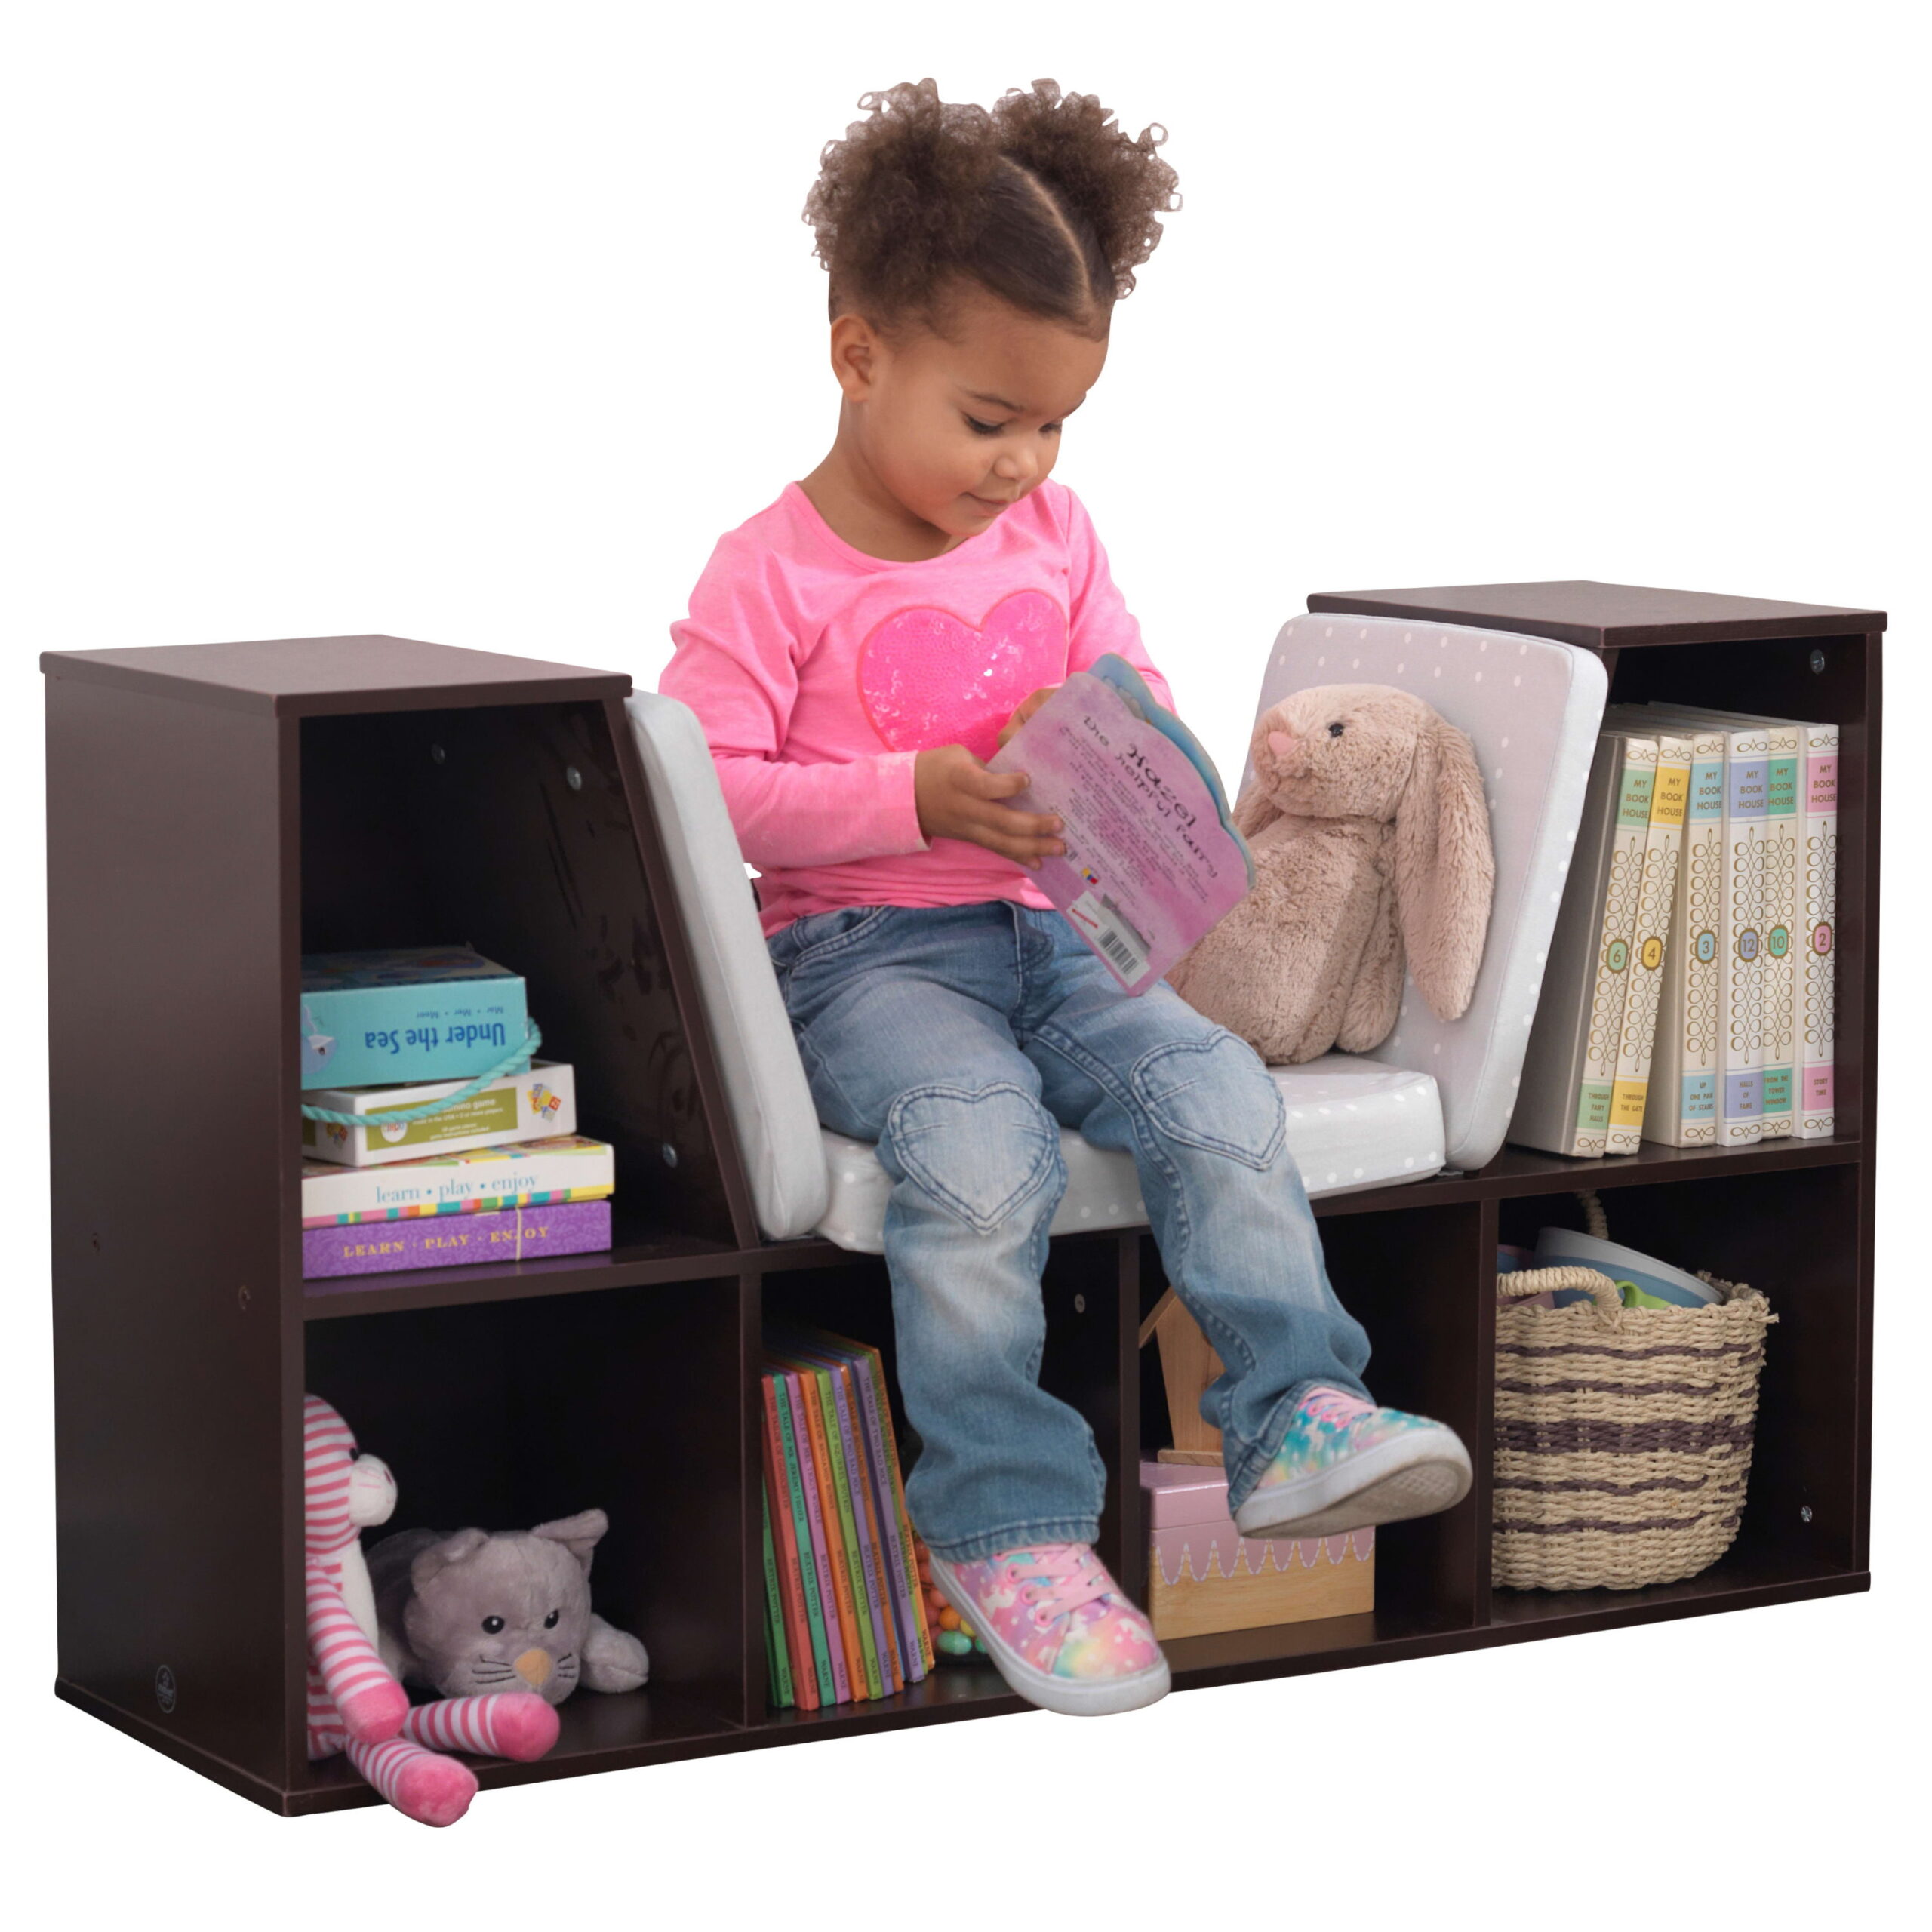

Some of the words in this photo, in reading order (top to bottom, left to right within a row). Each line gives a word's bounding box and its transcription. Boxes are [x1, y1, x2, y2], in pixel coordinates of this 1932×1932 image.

[1706, 771, 1718, 780] MY
[1746, 771, 1759, 779] MY
[1777, 768, 1789, 777] MY
[1820, 764, 1832, 774] MY
[1127, 743, 1197, 827] Hazel
[1634, 780, 1647, 788] MY
[1668, 778, 1681, 786] MY
[1770, 782, 1793, 791] BOOK
[1814, 779, 1835, 789] BOOK
[1700, 786, 1721, 795] BOOK
[1740, 785, 1763, 794] BOOK
[1084, 716, 1109, 746] the
[1115, 752, 1171, 817] helpful
[1176, 824, 1217, 878] fairy
[1626, 793, 1649, 804] BOOK
[1660, 792, 1683, 802] BOOK
[1738, 799, 1764, 809] HOUSE
[1768, 796, 1794, 806] HOUSE
[1811, 793, 1836, 803] HOUSE
[1657, 807, 1683, 817] HOUSE
[1697, 801, 1721, 811] HOUSE
[1623, 809, 1648, 819] HOUSE
[1743, 939, 1755, 952] 12
[1772, 935, 1784, 949] 10
[1819, 933, 1826, 946] 2
[1647, 947, 1656, 961] 4
[1702, 940, 1709, 955] 3
[1613, 949, 1621, 963] 6
[365, 1030, 399, 1054] Sea
[405, 1027, 438, 1052] the
[445, 1023, 506, 1048] Under
[473, 1099, 496, 1111] game
[376, 1186, 420, 1203] learn
[438, 1179, 473, 1202] play
[491, 1173, 538, 1195] enjoy
[343, 1240, 405, 1258] LEARN
[424, 1234, 470, 1250] PLAY
[863, 1377, 872, 1392] THE
[778, 1392, 786, 1408] THE
[824, 1391, 832, 1406] THE
[835, 1386, 844, 1401] THE
[866, 1395, 875, 1414] TALE
[827, 1407, 836, 1428] TALE
[838, 1402, 848, 1422] TALE
[781, 1410, 790, 1429] TALE
[869, 1416, 877, 1426] OF
[784, 1432, 792, 1442] OF
[830, 1430, 838, 1440] OF
[842, 1425, 850, 1435] OF
[871, 1429, 881, 1448] TWO
[875, 1448, 884, 1466] BAD
[901, 1524, 912, 1557] BEATRIX
[907, 1557, 918, 1589] POTTER
[803, 1551, 814, 1585] BEATRIX
[820, 1553, 831, 1587] BEATRIX
[889, 1534, 901, 1567] BEATRIX
[895, 1568, 906, 1599] POTTER
[862, 1544, 874, 1577] BEATRIX
[868, 1579, 879, 1609] POTTER
[870, 1541, 882, 1576] BEATRIX
[876, 1576, 888, 1607] POTTER
[836, 1549, 848, 1582] BEATRIX
[842, 1584, 854, 1614] POTTER
[851, 1549, 863, 1583] BEATRIX
[857, 1584, 868, 1617] POTTER
[808, 1586, 819, 1617] POTTER
[825, 1588, 836, 1619] POTTER
